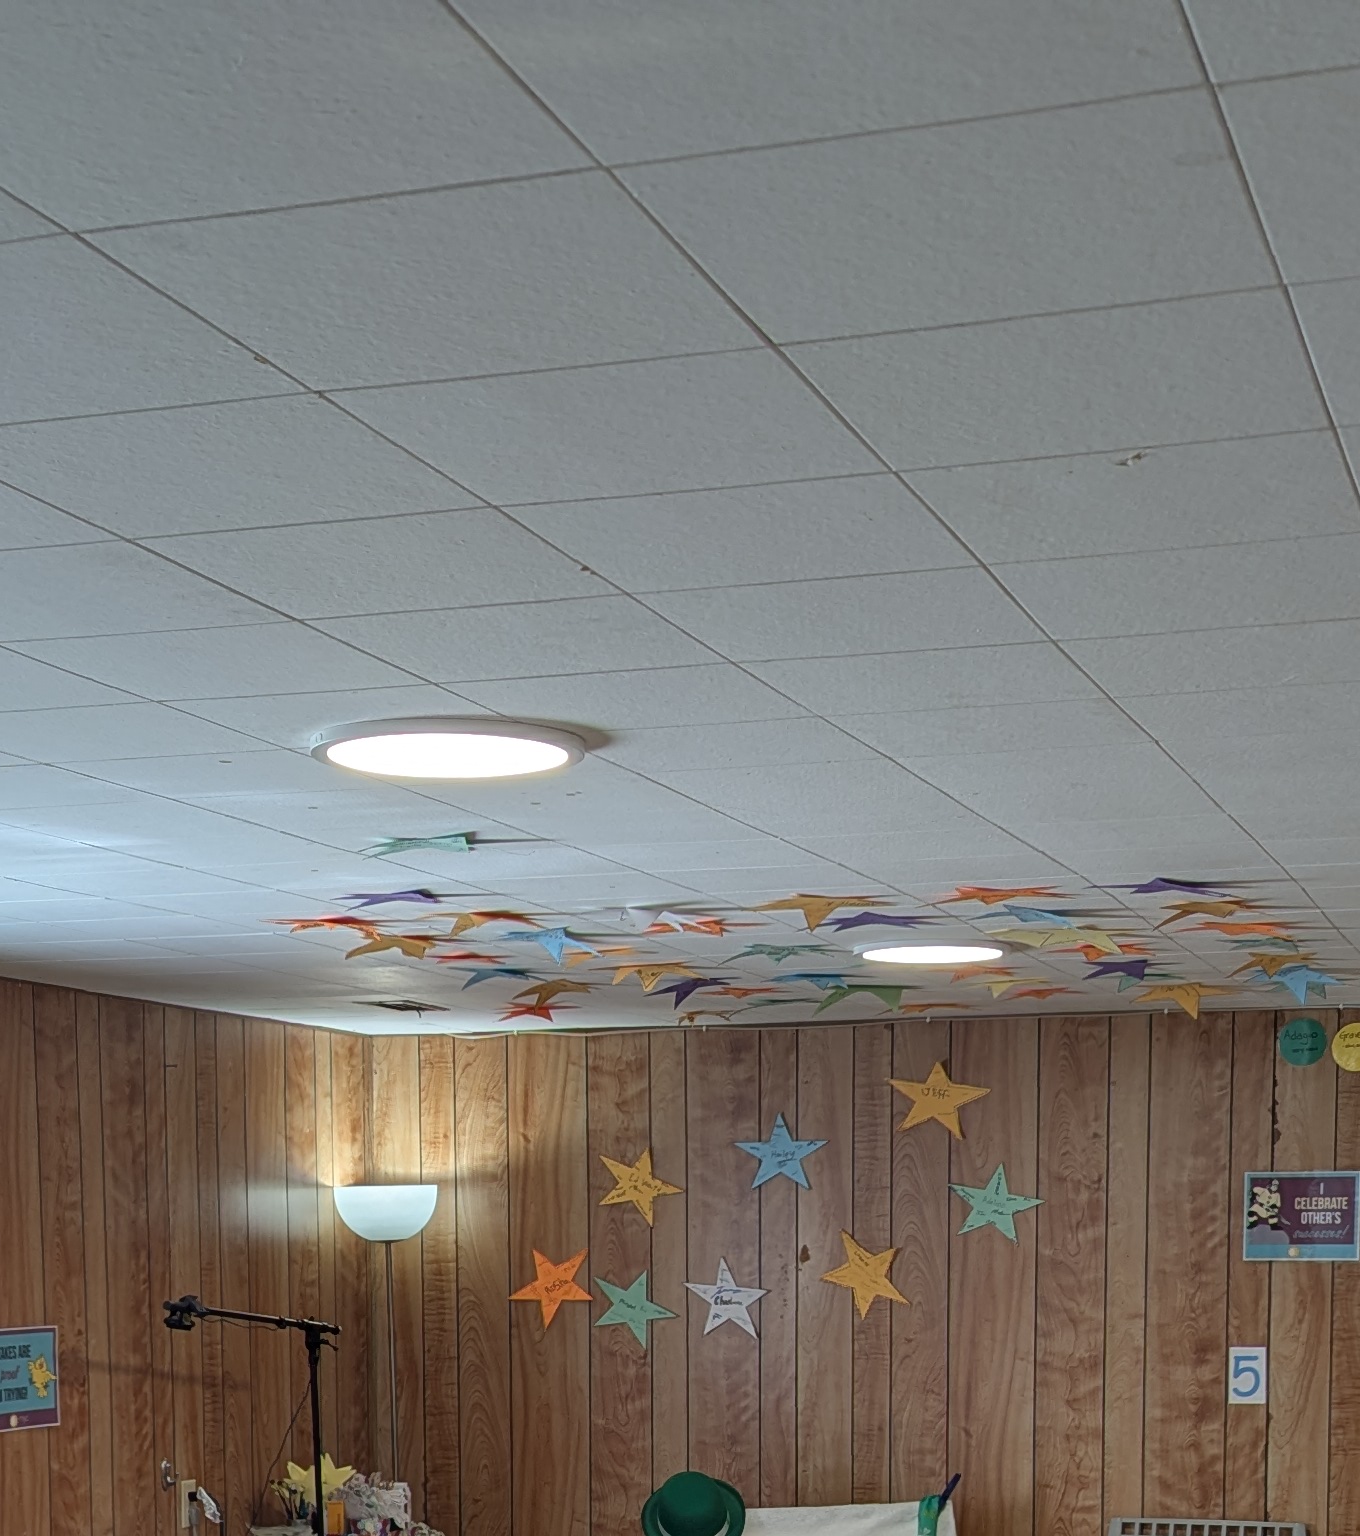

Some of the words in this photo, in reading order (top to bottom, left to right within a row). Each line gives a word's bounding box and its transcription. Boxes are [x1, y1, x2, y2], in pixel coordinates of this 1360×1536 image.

[1283, 1030, 1318, 1045] Adagio
[1294, 1196, 1349, 1210] CELEBRATE
[1300, 1211, 1342, 1225] OTHER'S
[18, 1344, 31, 1358] ARE
[1231, 1354, 1260, 1397] 5
